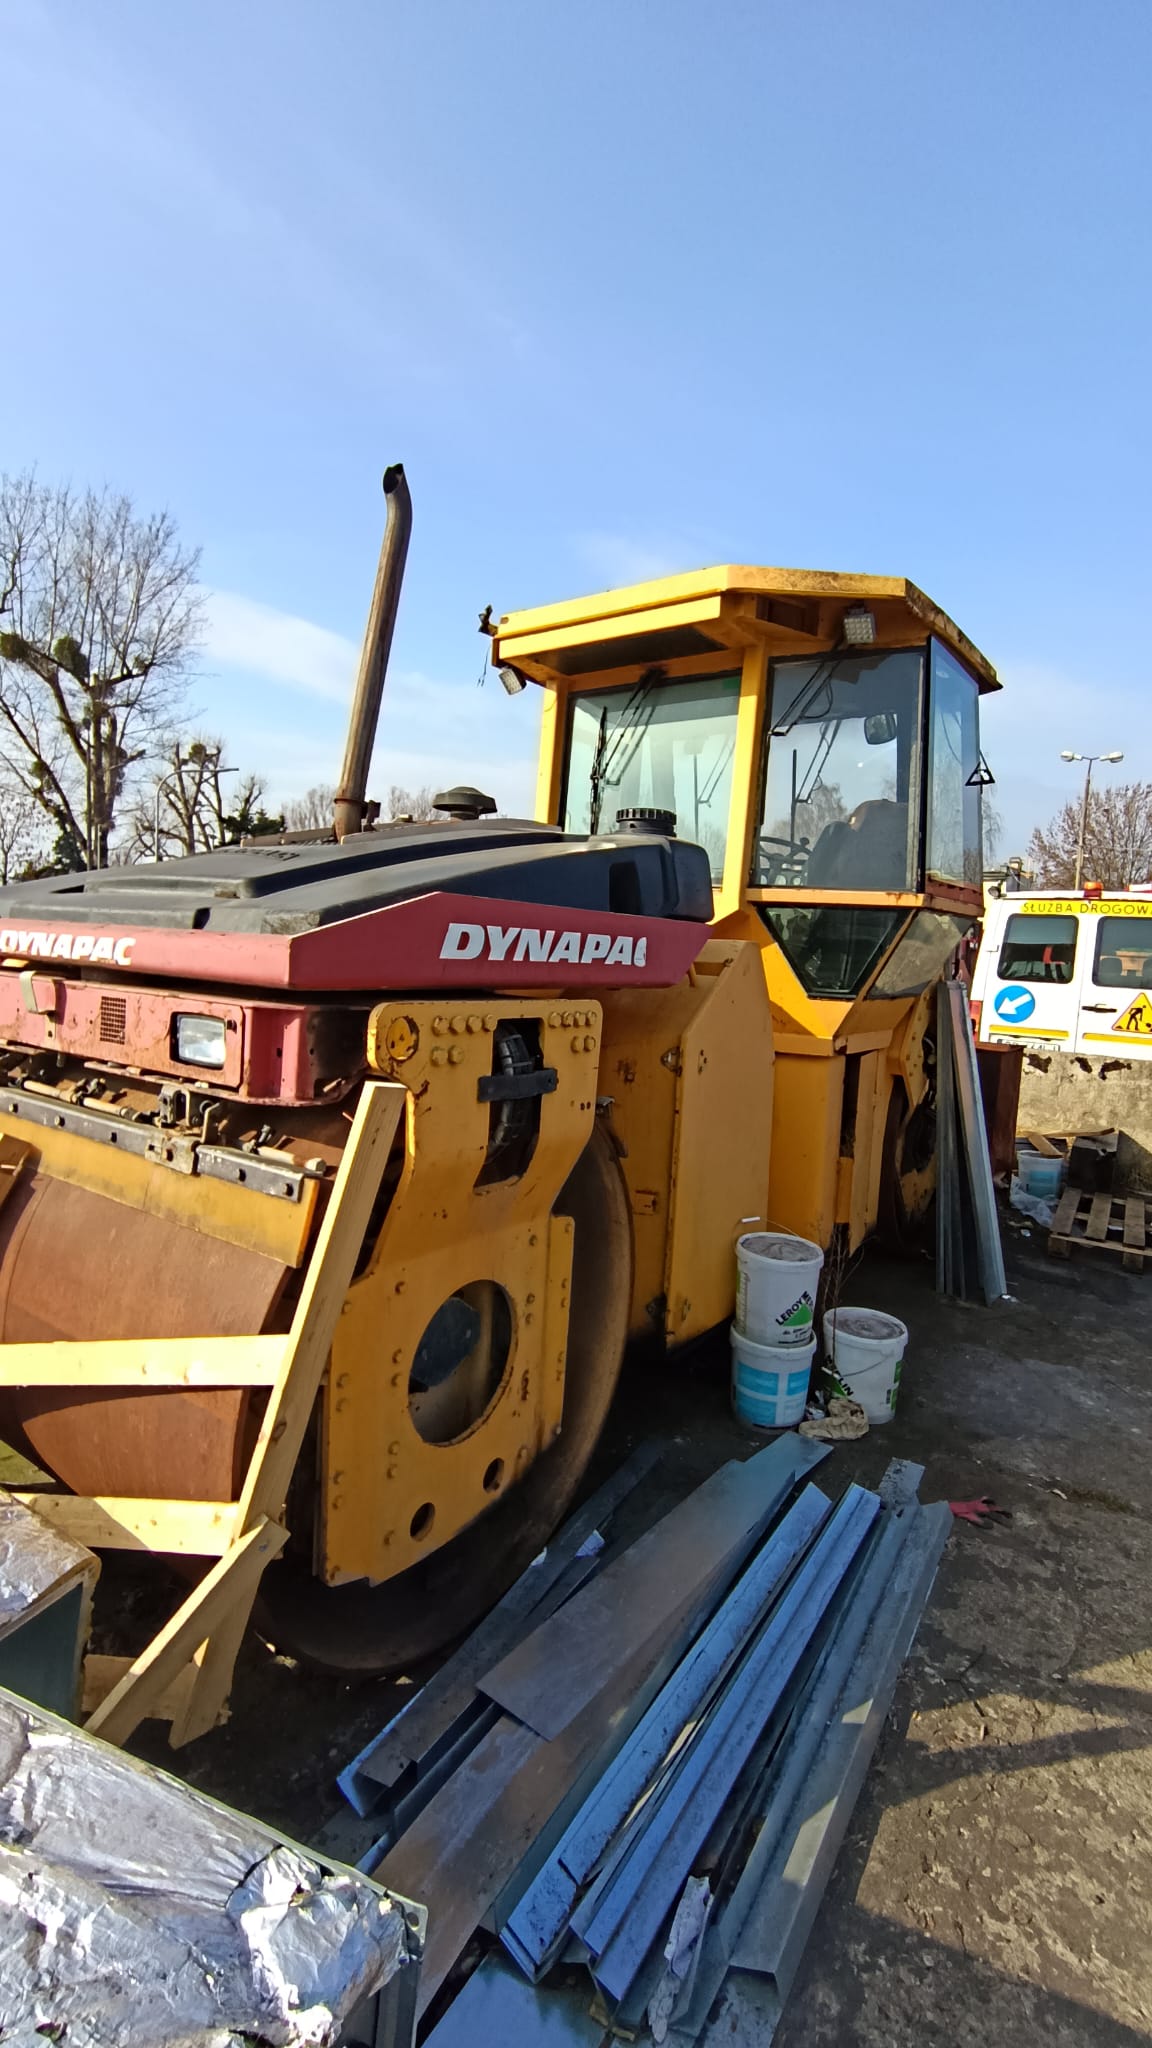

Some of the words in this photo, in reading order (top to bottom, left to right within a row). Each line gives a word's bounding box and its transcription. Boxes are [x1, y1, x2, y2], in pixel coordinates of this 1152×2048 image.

[1079, 903, 1152, 915] DROGOW
[0, 930, 136, 966] DYNAPAC
[775, 1297, 803, 1325] LEROY
